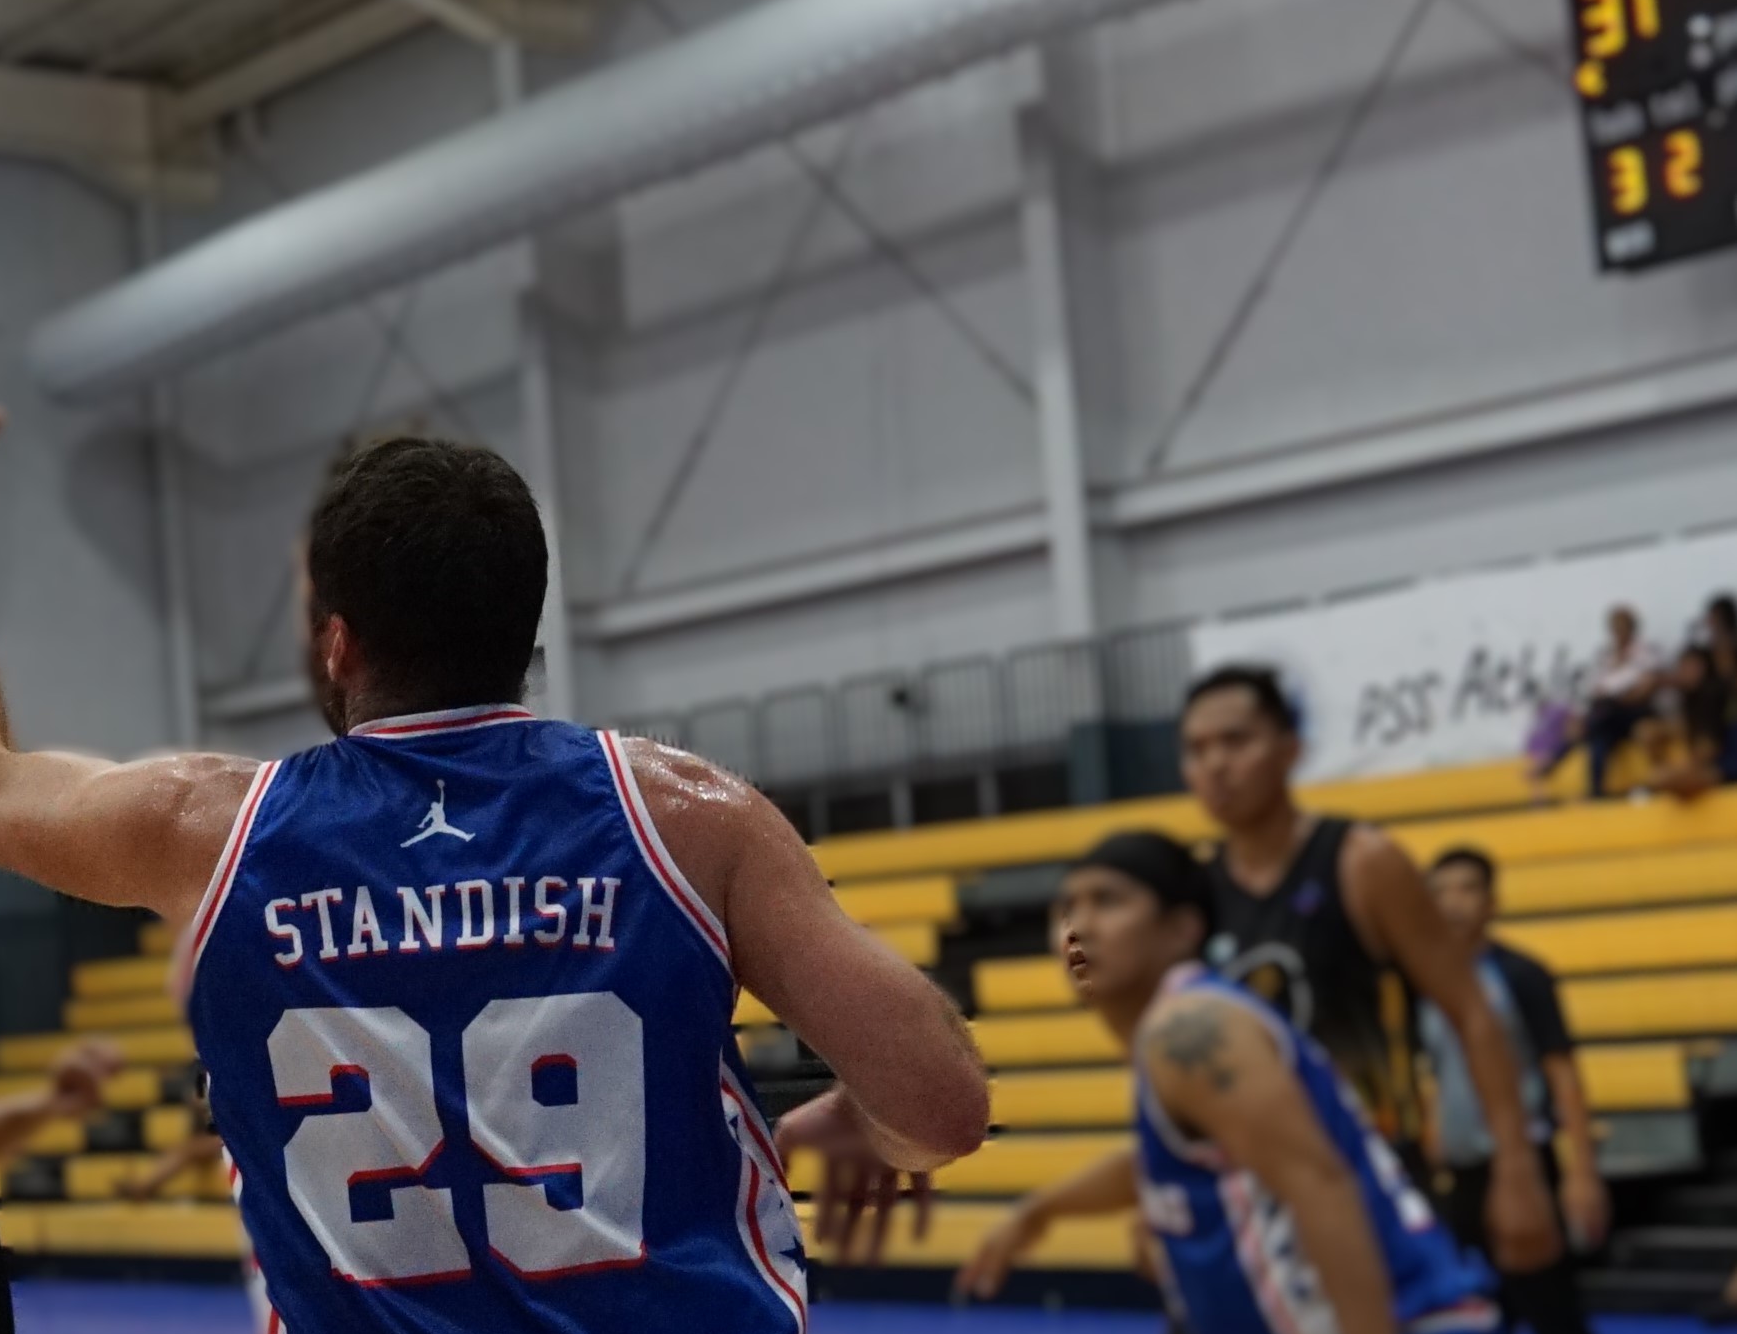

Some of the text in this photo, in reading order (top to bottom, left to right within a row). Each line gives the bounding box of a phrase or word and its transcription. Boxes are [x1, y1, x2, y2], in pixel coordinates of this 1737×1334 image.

[1354, 671, 1443, 745] PSS
[265, 876, 621, 967] STANDISH
[266, 991, 647, 1289] 29
